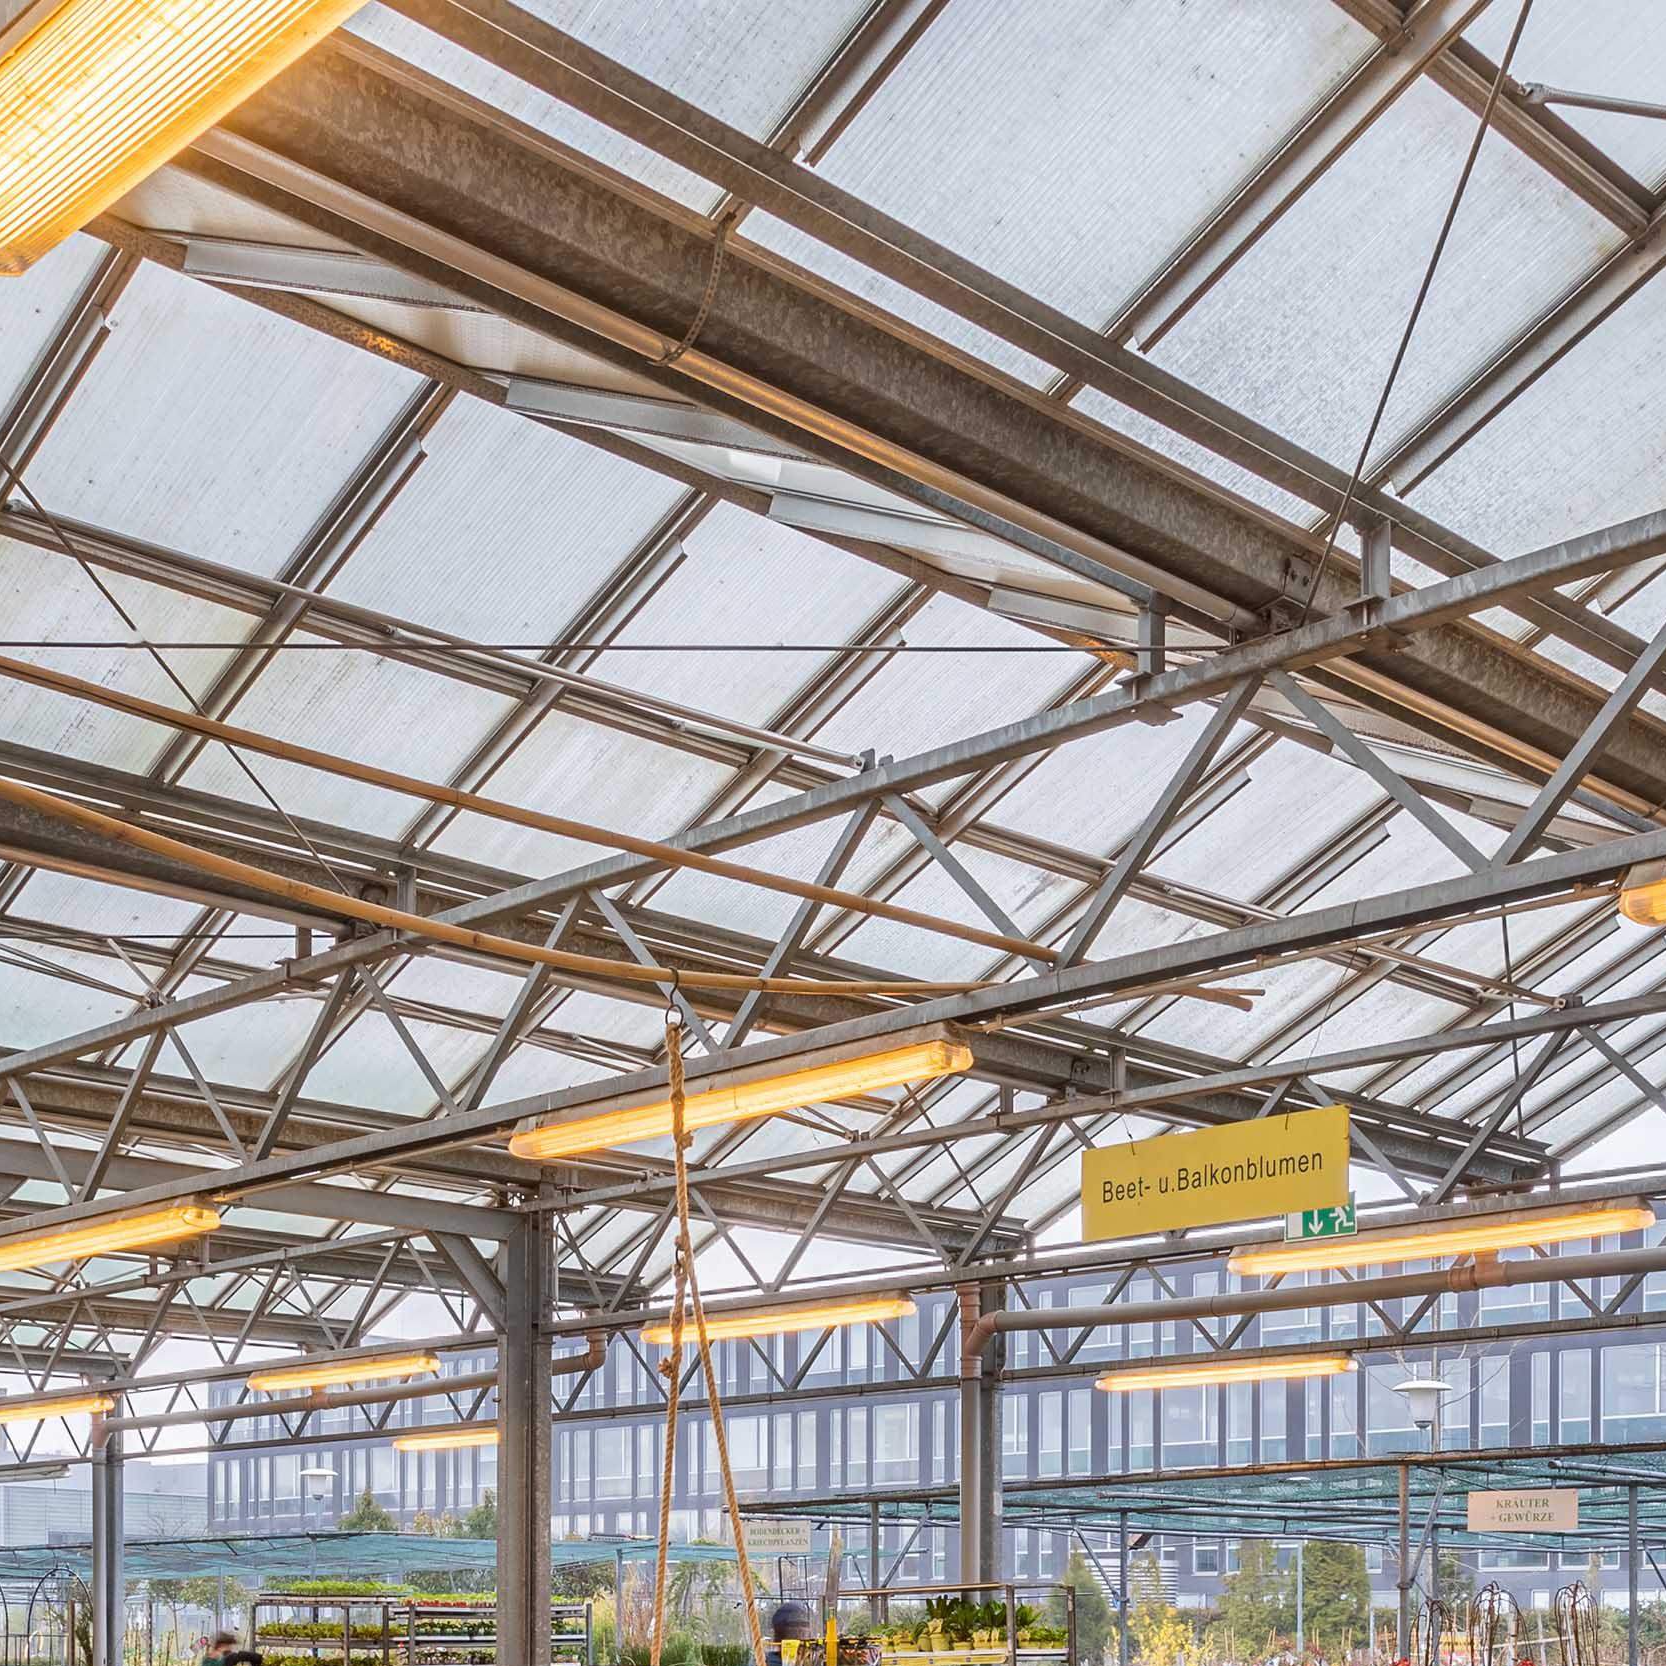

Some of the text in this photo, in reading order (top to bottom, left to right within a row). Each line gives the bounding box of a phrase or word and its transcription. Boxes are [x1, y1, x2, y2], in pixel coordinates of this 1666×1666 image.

[1102, 1176, 1151, 1203] Beet-
[1496, 1497, 1550, 1509] KRÄUTER
[1499, 1511, 1555, 1522] GEWÜRZE
